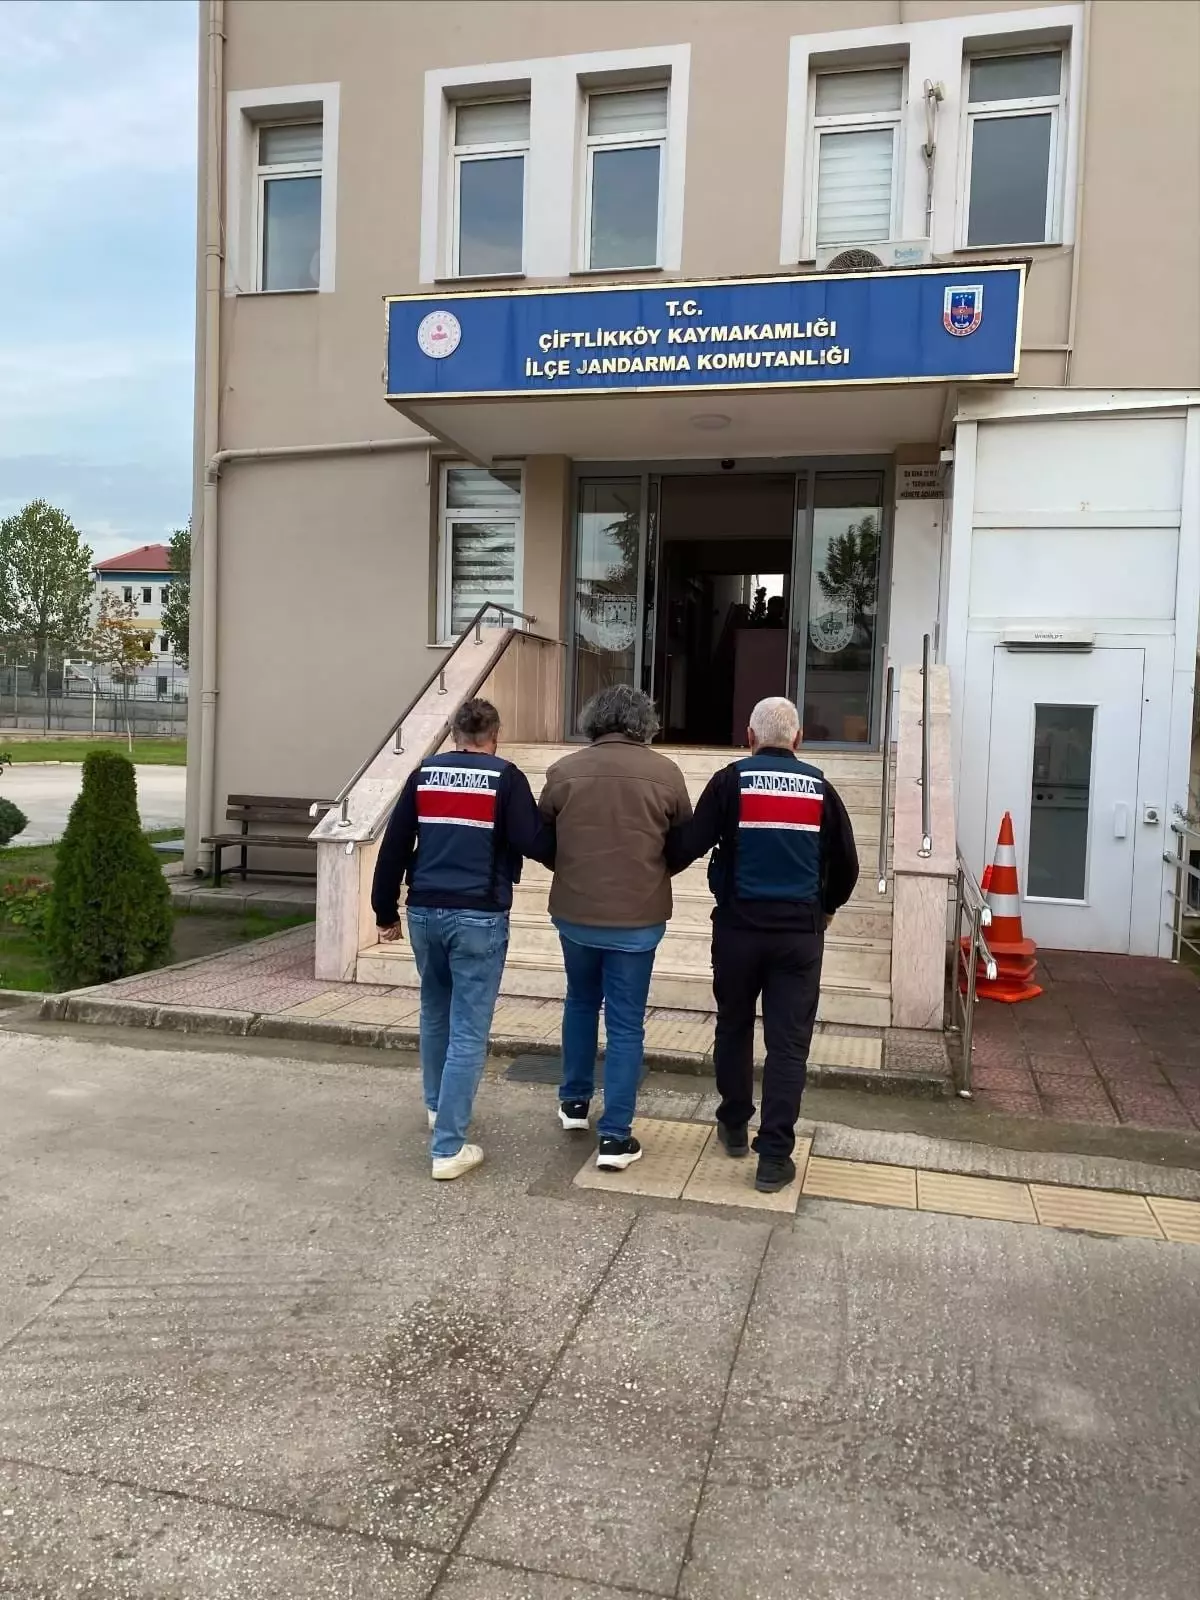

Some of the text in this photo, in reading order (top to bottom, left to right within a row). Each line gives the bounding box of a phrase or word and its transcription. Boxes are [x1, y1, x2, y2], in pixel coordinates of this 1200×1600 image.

[665, 300, 703, 317] T.C.
[538, 317, 837, 353] ÇİFTLİKKÖY KAYMAKAMLIĞI
[525, 345, 850, 380] İLÇE JANDARMA KOMUTANLIĞI
[425, 770, 489, 789] JANDARMA
[748, 775, 817, 794] JANDARMA
